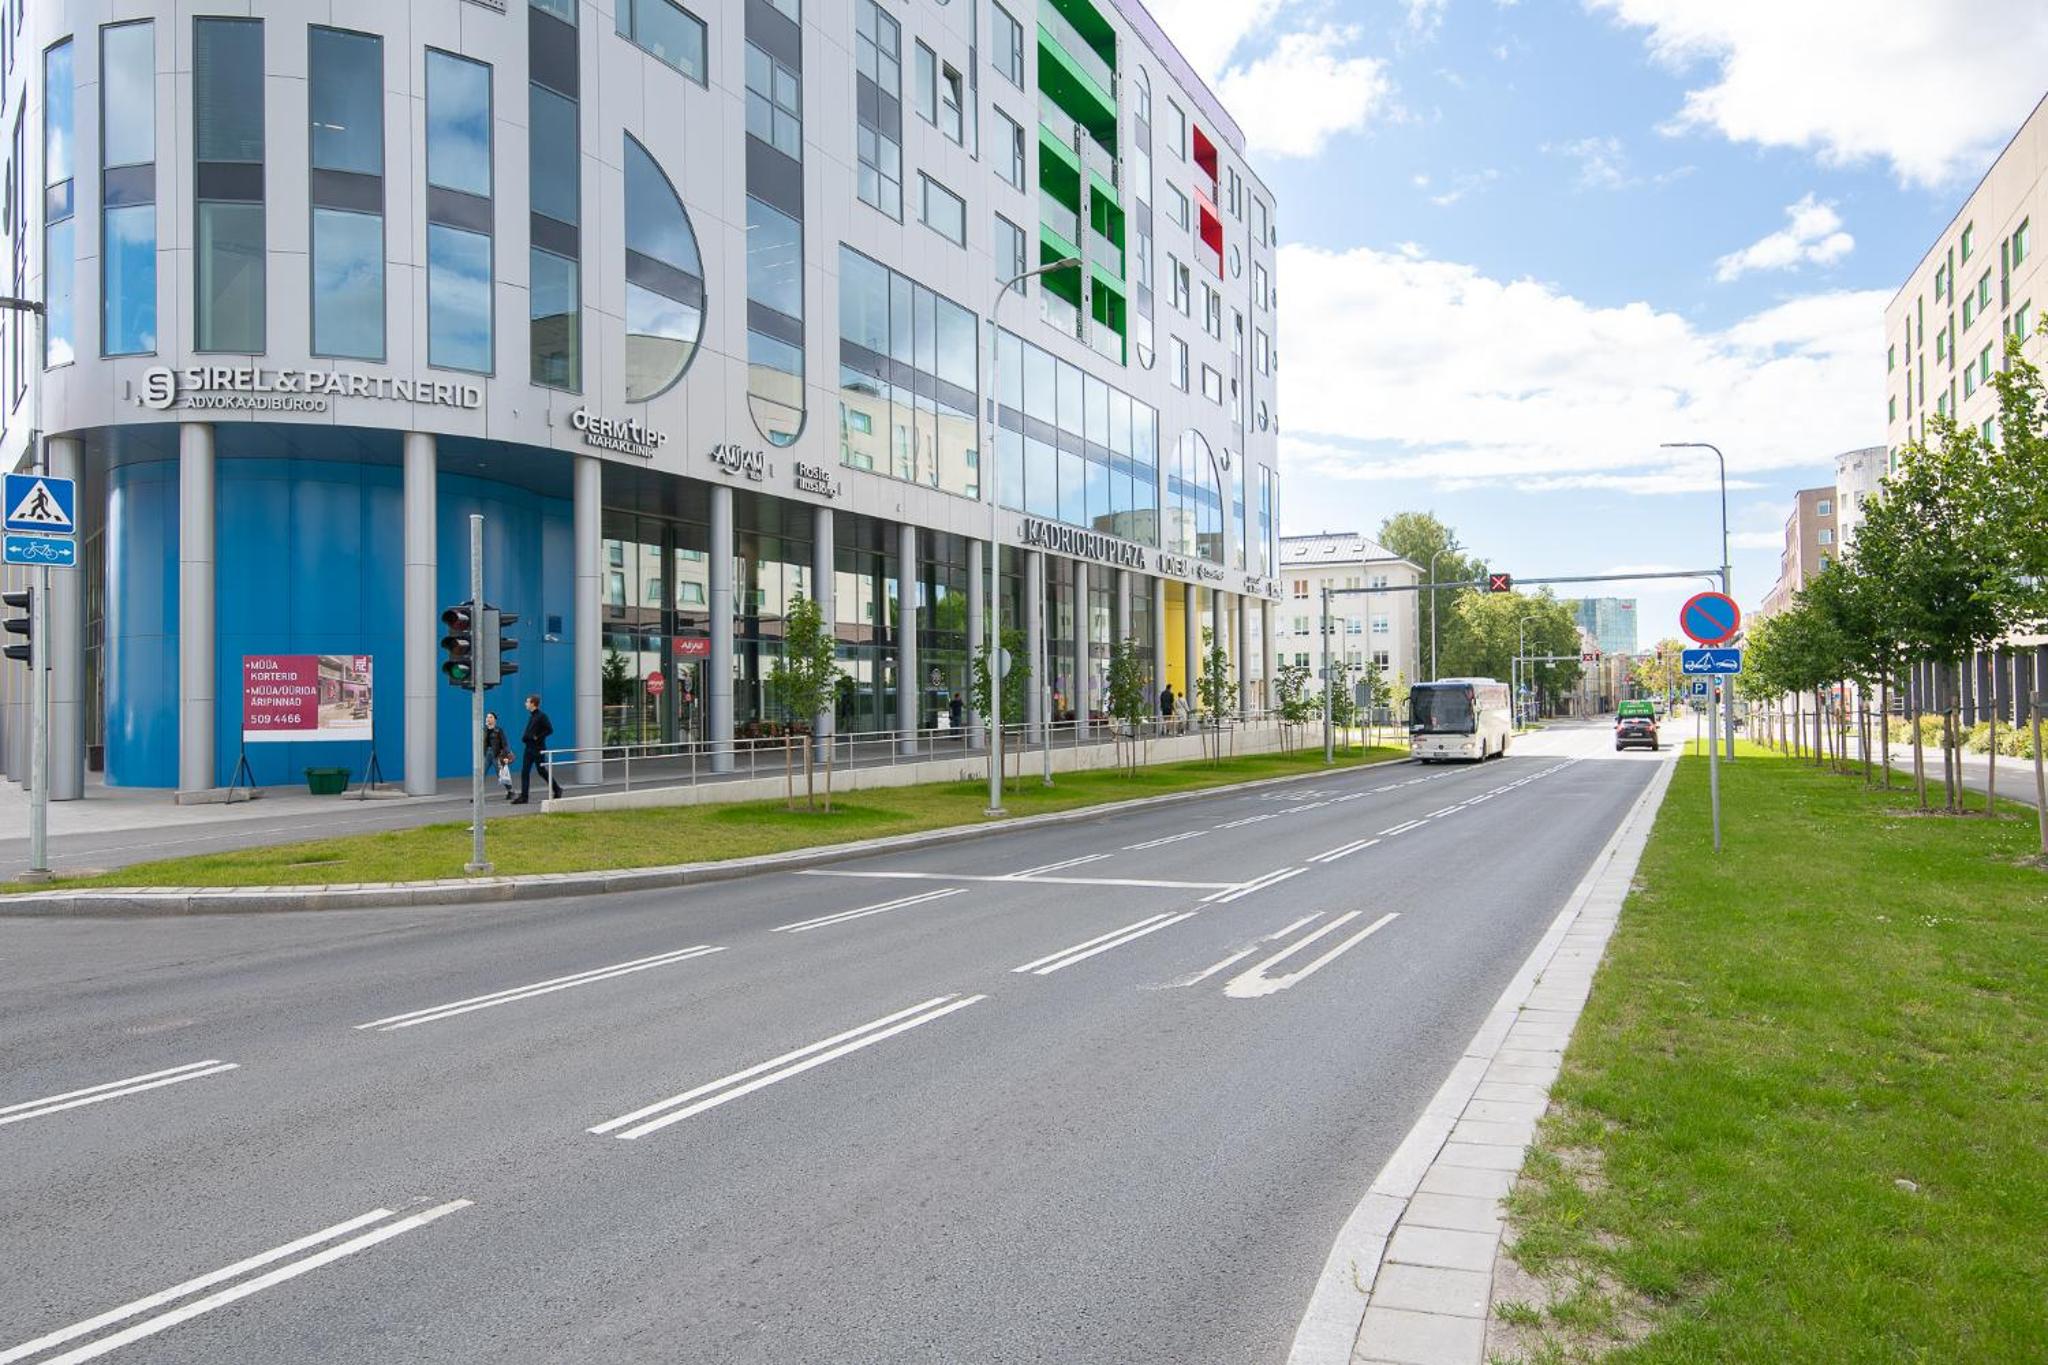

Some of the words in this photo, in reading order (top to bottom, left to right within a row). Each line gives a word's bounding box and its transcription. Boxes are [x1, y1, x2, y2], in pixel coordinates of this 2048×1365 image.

[184, 367, 272, 391] SIREL
[276, 370, 299, 392] &
[303, 370, 483, 409] PARTNERID
[186, 396, 327, 412] ADVOKAADIBÜROO
[1028, 519, 1106, 560] KADRIORU
[1110, 539, 1146, 570] PLAZA
[1695, 683, 1704, 694] P
[251, 714, 271, 724] 509
[274, 713, 301, 724] 4466
